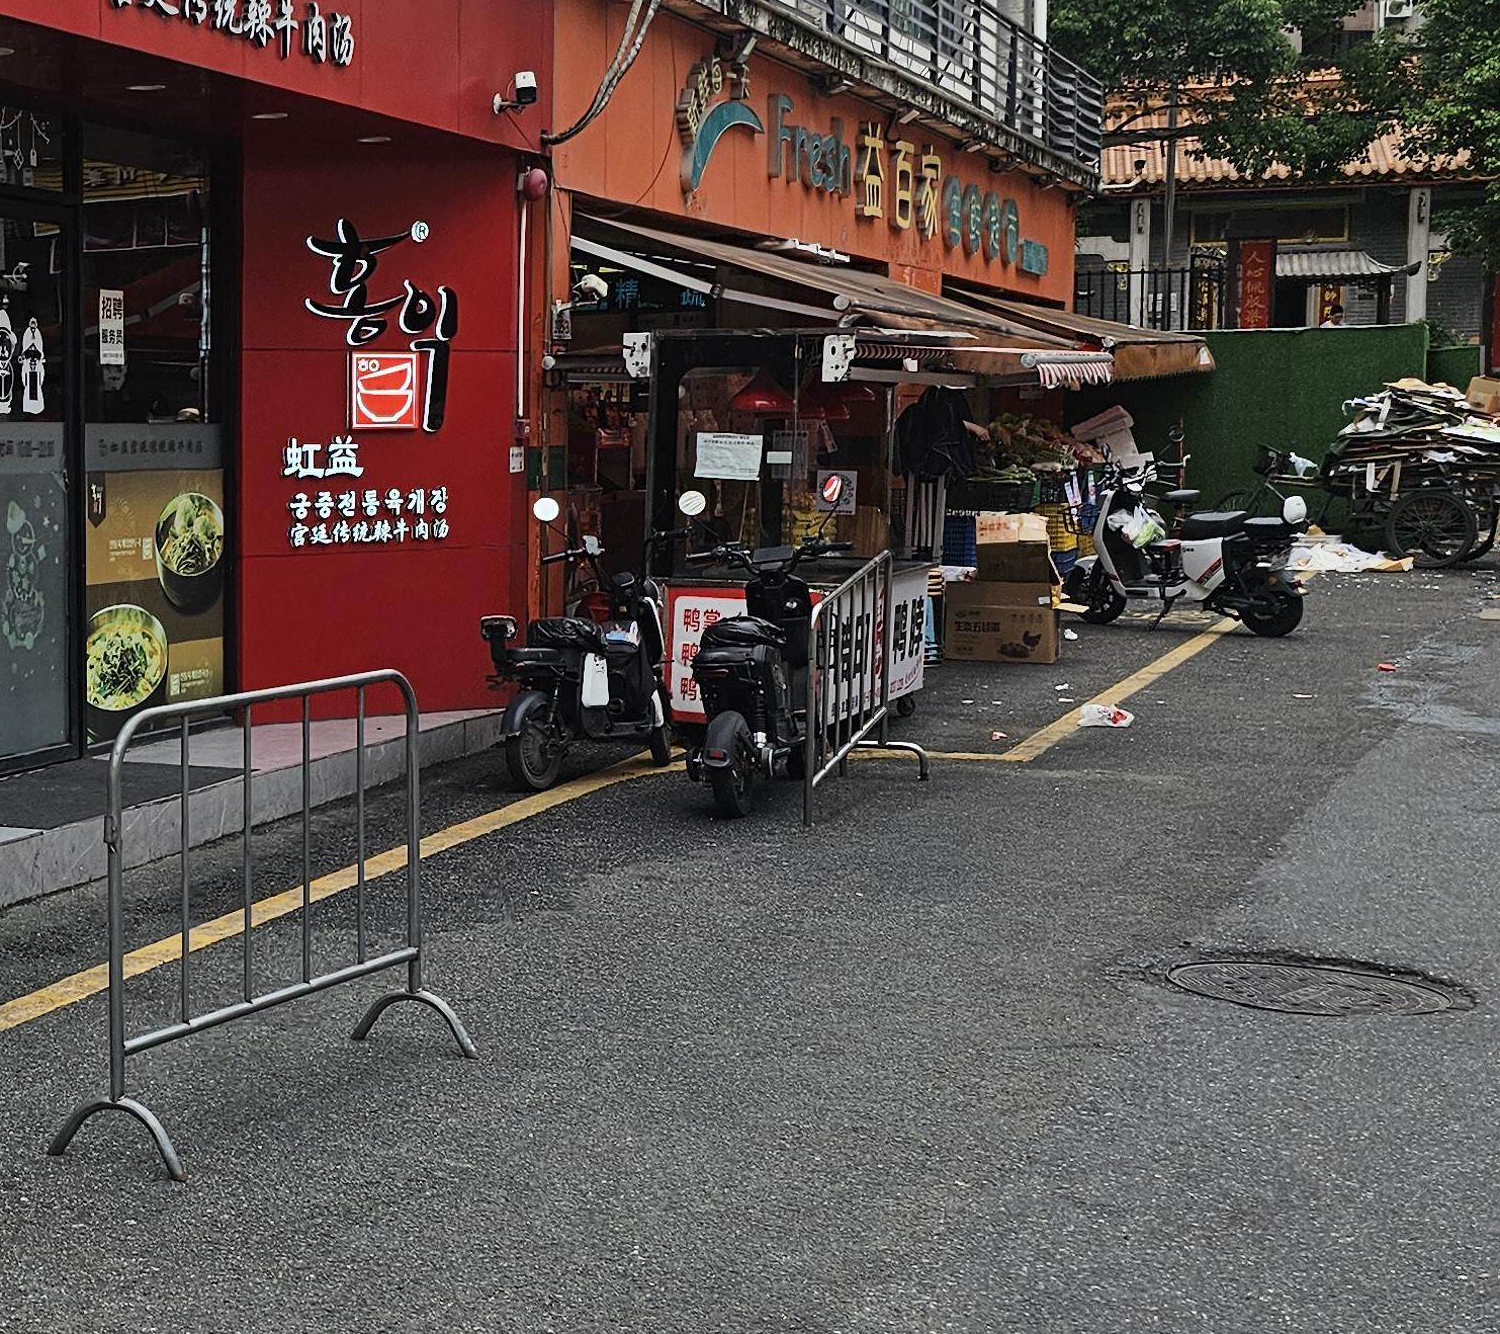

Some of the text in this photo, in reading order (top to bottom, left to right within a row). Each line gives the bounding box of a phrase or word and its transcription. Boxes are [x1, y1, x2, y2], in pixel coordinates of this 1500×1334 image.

[768, 94, 851, 198] Fresh
[860, 121, 942, 241] 益百家
[102, 297, 123, 321] 招聘
[283, 435, 364, 479] 虹益
[288, 487, 449, 520] 궁중전통육개장
[289, 522, 450, 547] 宫廷传统辣牛肉汤
